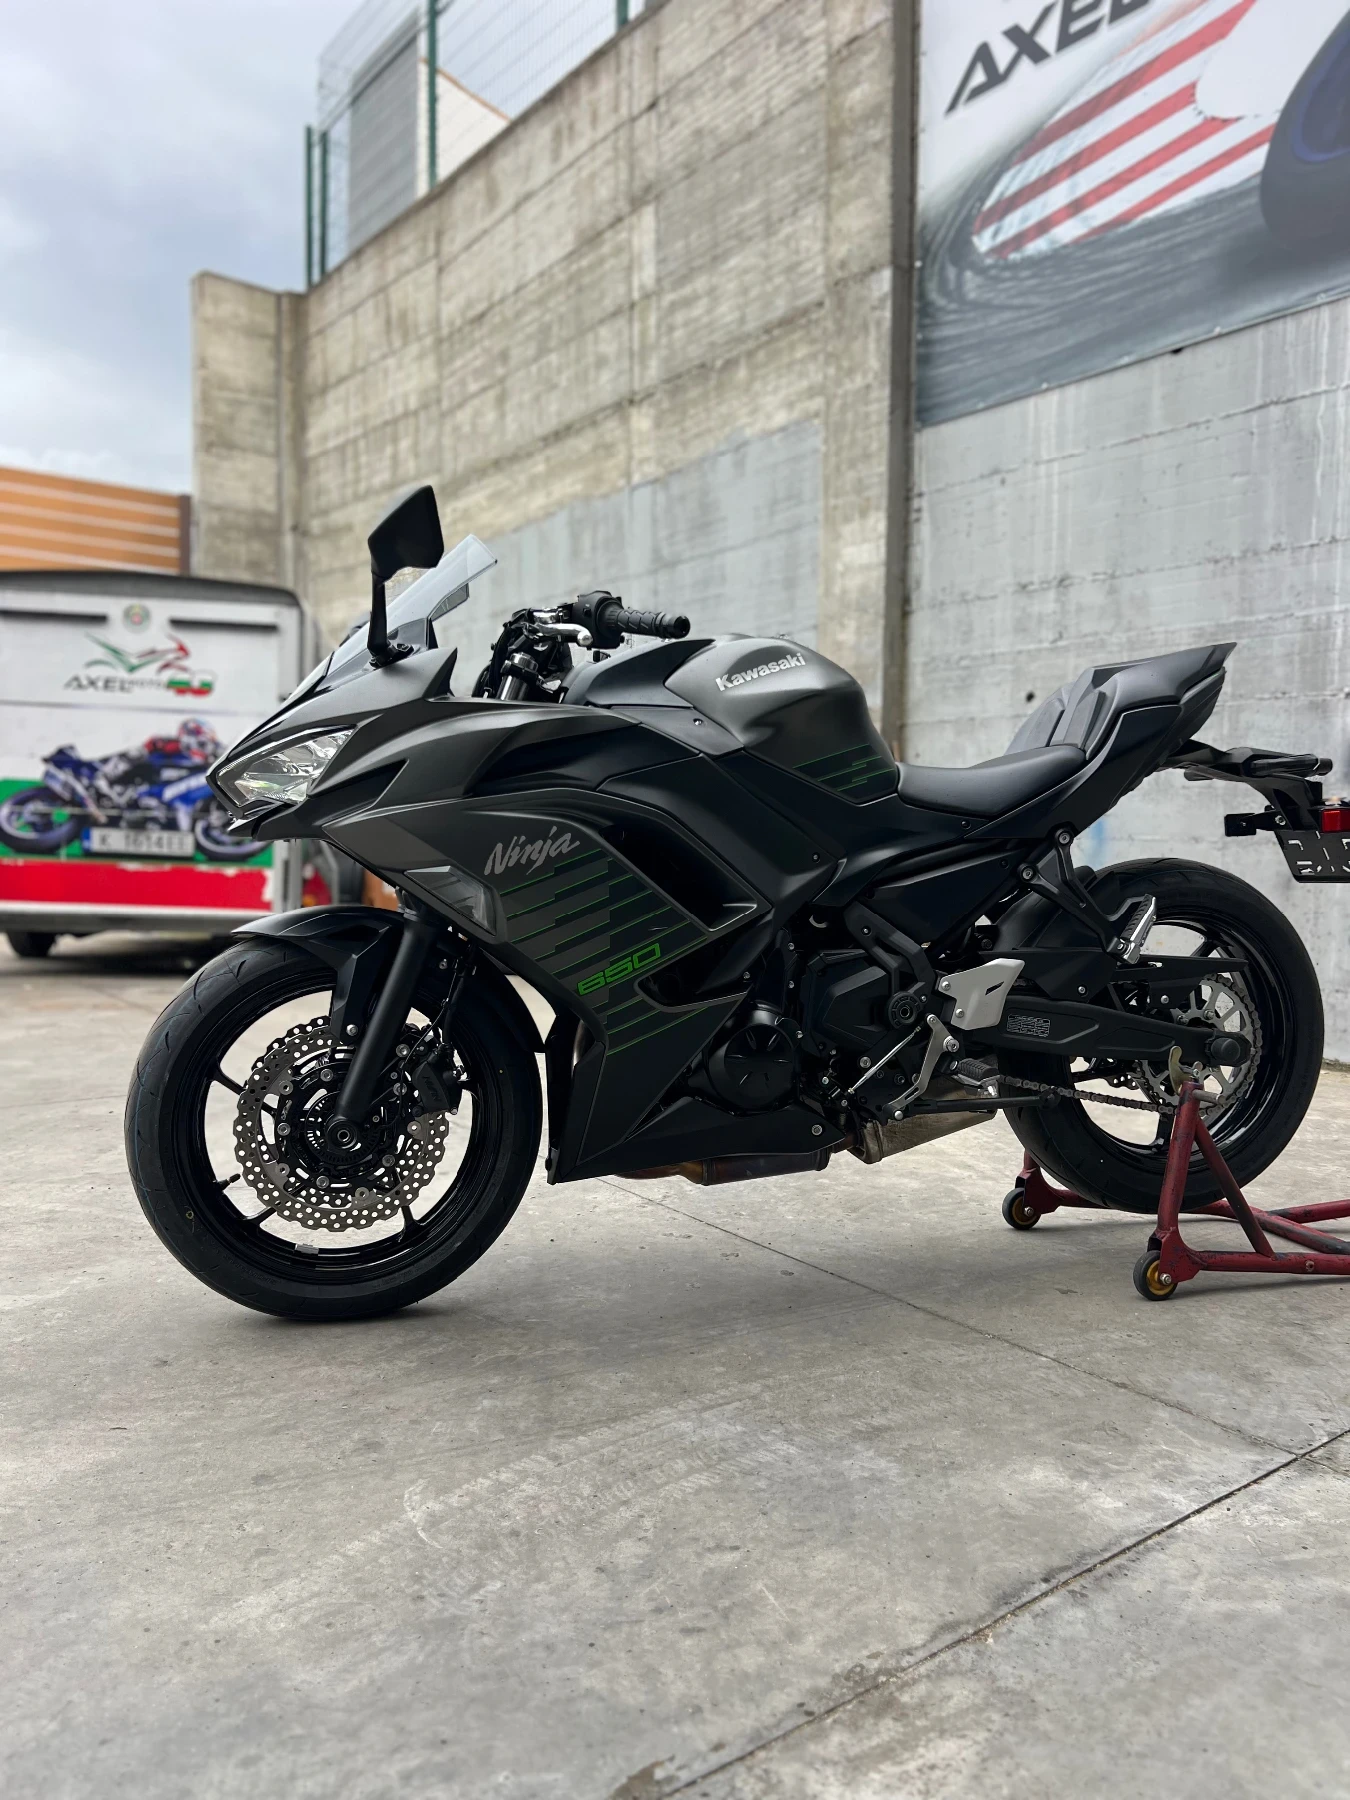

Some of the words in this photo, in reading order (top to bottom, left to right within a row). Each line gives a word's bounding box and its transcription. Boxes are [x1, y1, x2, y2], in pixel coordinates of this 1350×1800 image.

[63, 675, 134, 693] AXEL
[715, 652, 806, 691] Kawasaki
[483, 825, 580, 876] Ninja
[577, 942, 661, 996] 650
